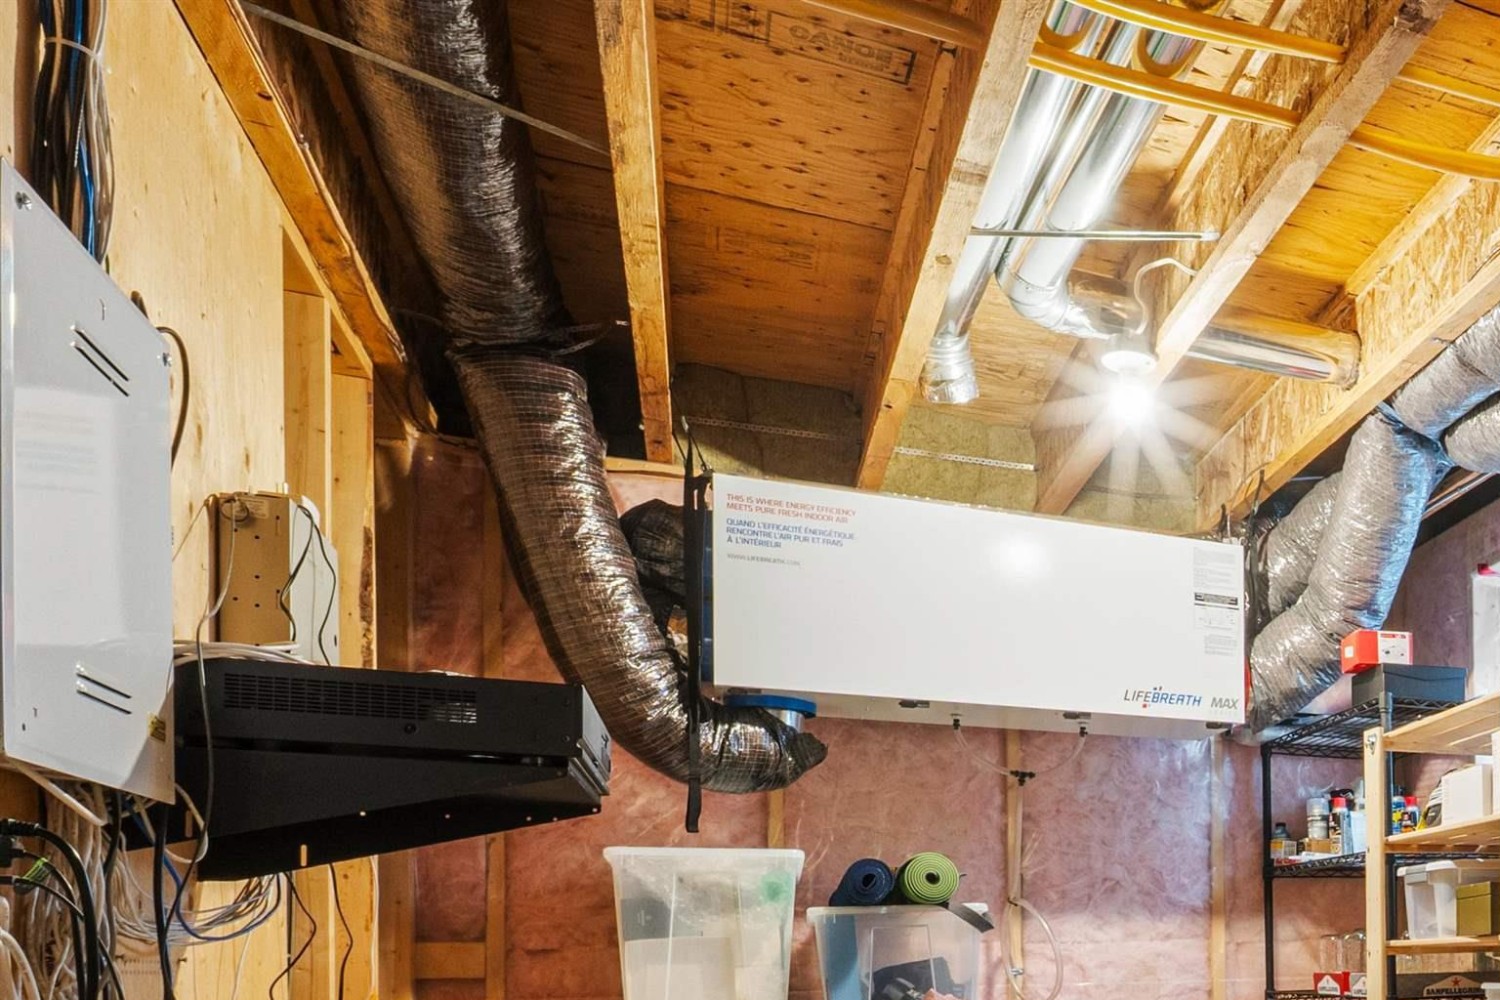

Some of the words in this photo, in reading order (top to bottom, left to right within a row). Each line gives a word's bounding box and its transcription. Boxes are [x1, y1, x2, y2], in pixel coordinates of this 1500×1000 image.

[727, 503, 753, 511] MEETS
[756, 506, 776, 515] PURE
[778, 509, 802, 518] FRESH
[805, 513, 833, 522] INDOOR
[756, 498, 782, 508] WHERE
[786, 502, 814, 511] ENERGY
[817, 505, 856, 516] EFFICIENCY
[727, 518, 755, 528] QUAND
[758, 521, 801, 533] L'EFFICACITÉ
[804, 527, 855, 540] ÉNERGÉTIQUE
[727, 527, 773, 539] RENCONTRE
[774, 532, 792, 540] L'AIR
[794, 535, 809, 543] PUR
[823, 538, 843, 547] FRAIS
[736, 537, 781, 548] L'INTÉRIEUR
[1124, 688, 1202, 707] LIFEBREATH
[1211, 697, 1239, 710] MAX
